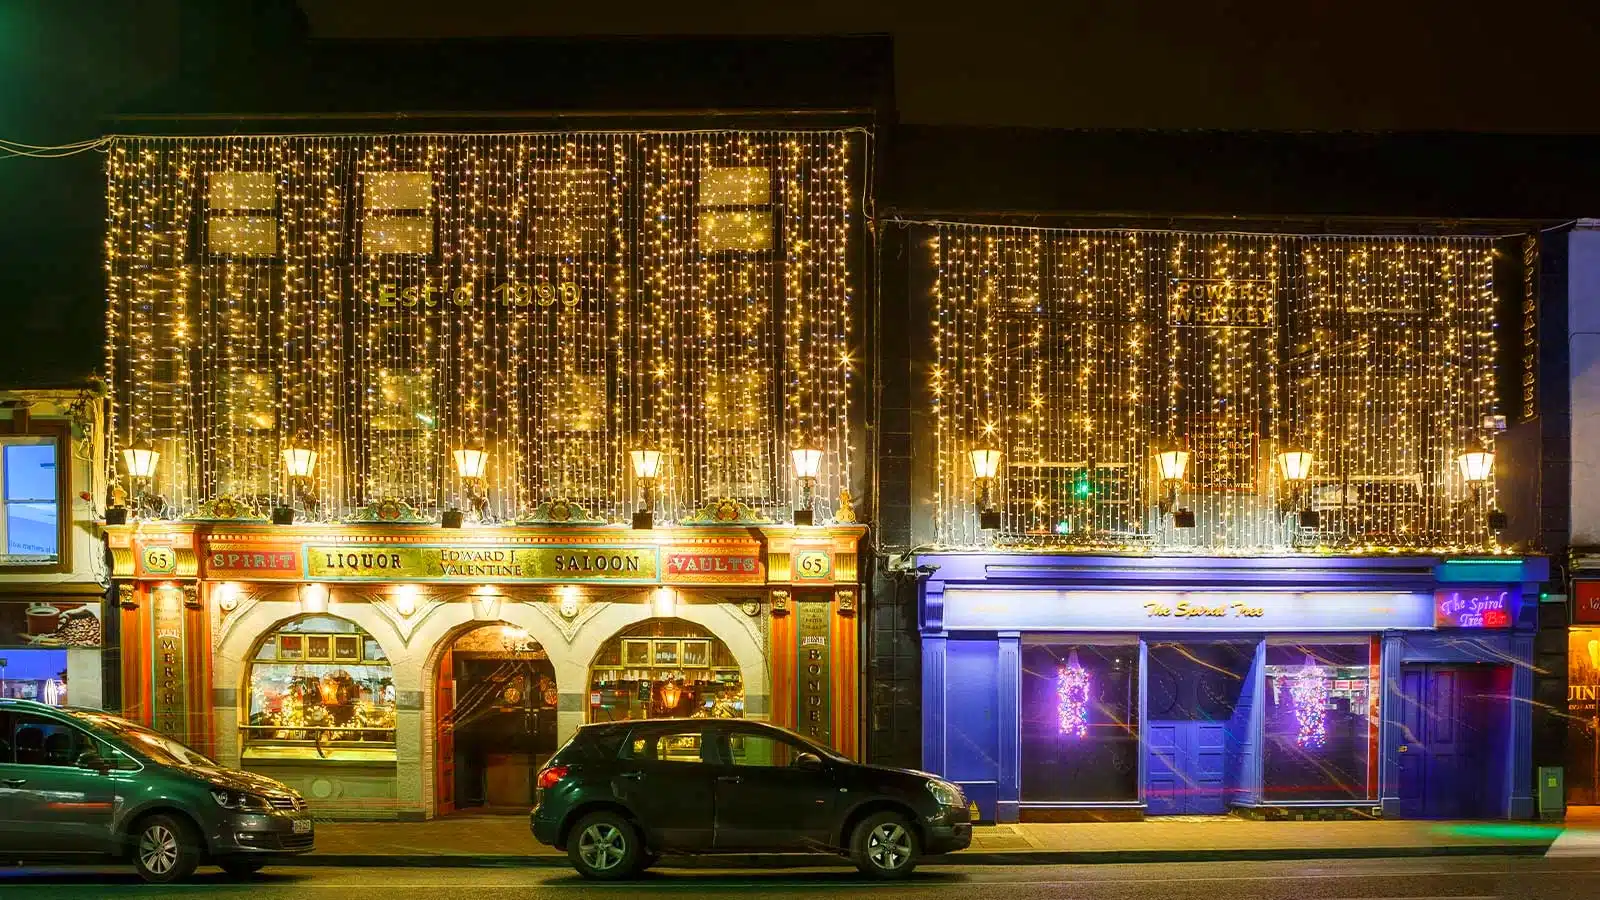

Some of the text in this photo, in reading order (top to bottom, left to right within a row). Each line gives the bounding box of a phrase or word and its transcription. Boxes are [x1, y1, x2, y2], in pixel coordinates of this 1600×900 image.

[494, 282, 581, 307] 1990
[1178, 282, 1269, 300] POWERS
[1173, 304, 1274, 322] WHISKEY
[148, 551, 167, 568] 65
[213, 553, 293, 568] SPIRIT
[326, 553, 401, 569] LIQUOR
[441, 549, 504, 561] EDWARD
[555, 555, 640, 571] SALOON
[802, 555, 822, 571] 65
[440, 564, 522, 576] VALENTINE
[671, 557, 755, 571] VAULTS
[1144, 600, 1265, 619] The Spiral Tree
[1441, 592, 1508, 615] The Spiral
[1460, 613, 1483, 627] Tree
